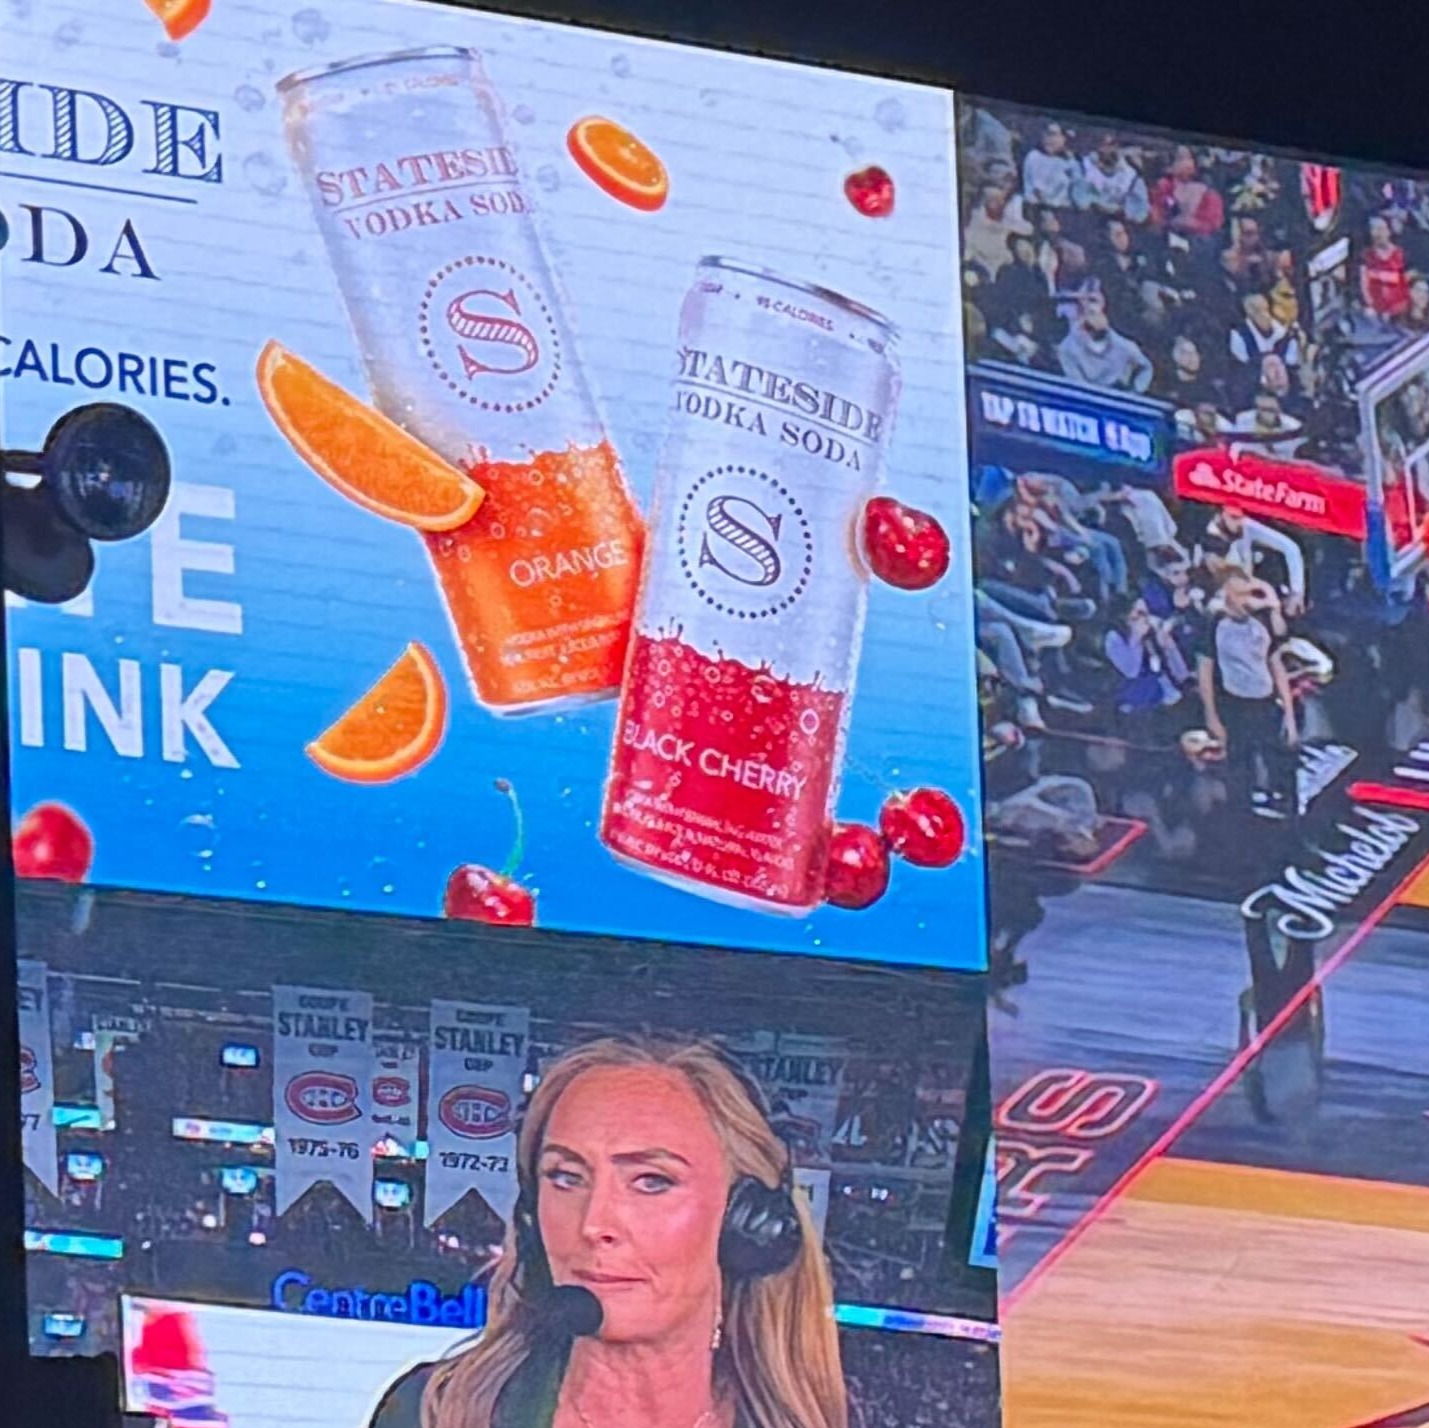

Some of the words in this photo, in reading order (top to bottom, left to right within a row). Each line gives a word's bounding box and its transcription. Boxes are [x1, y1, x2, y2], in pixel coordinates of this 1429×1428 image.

[510, 539, 628, 588] ORANGE
[699, 746, 807, 802] CHERRY
[278, 1012, 371, 1042] STANLEY
[435, 1026, 526, 1058] STANLEY
